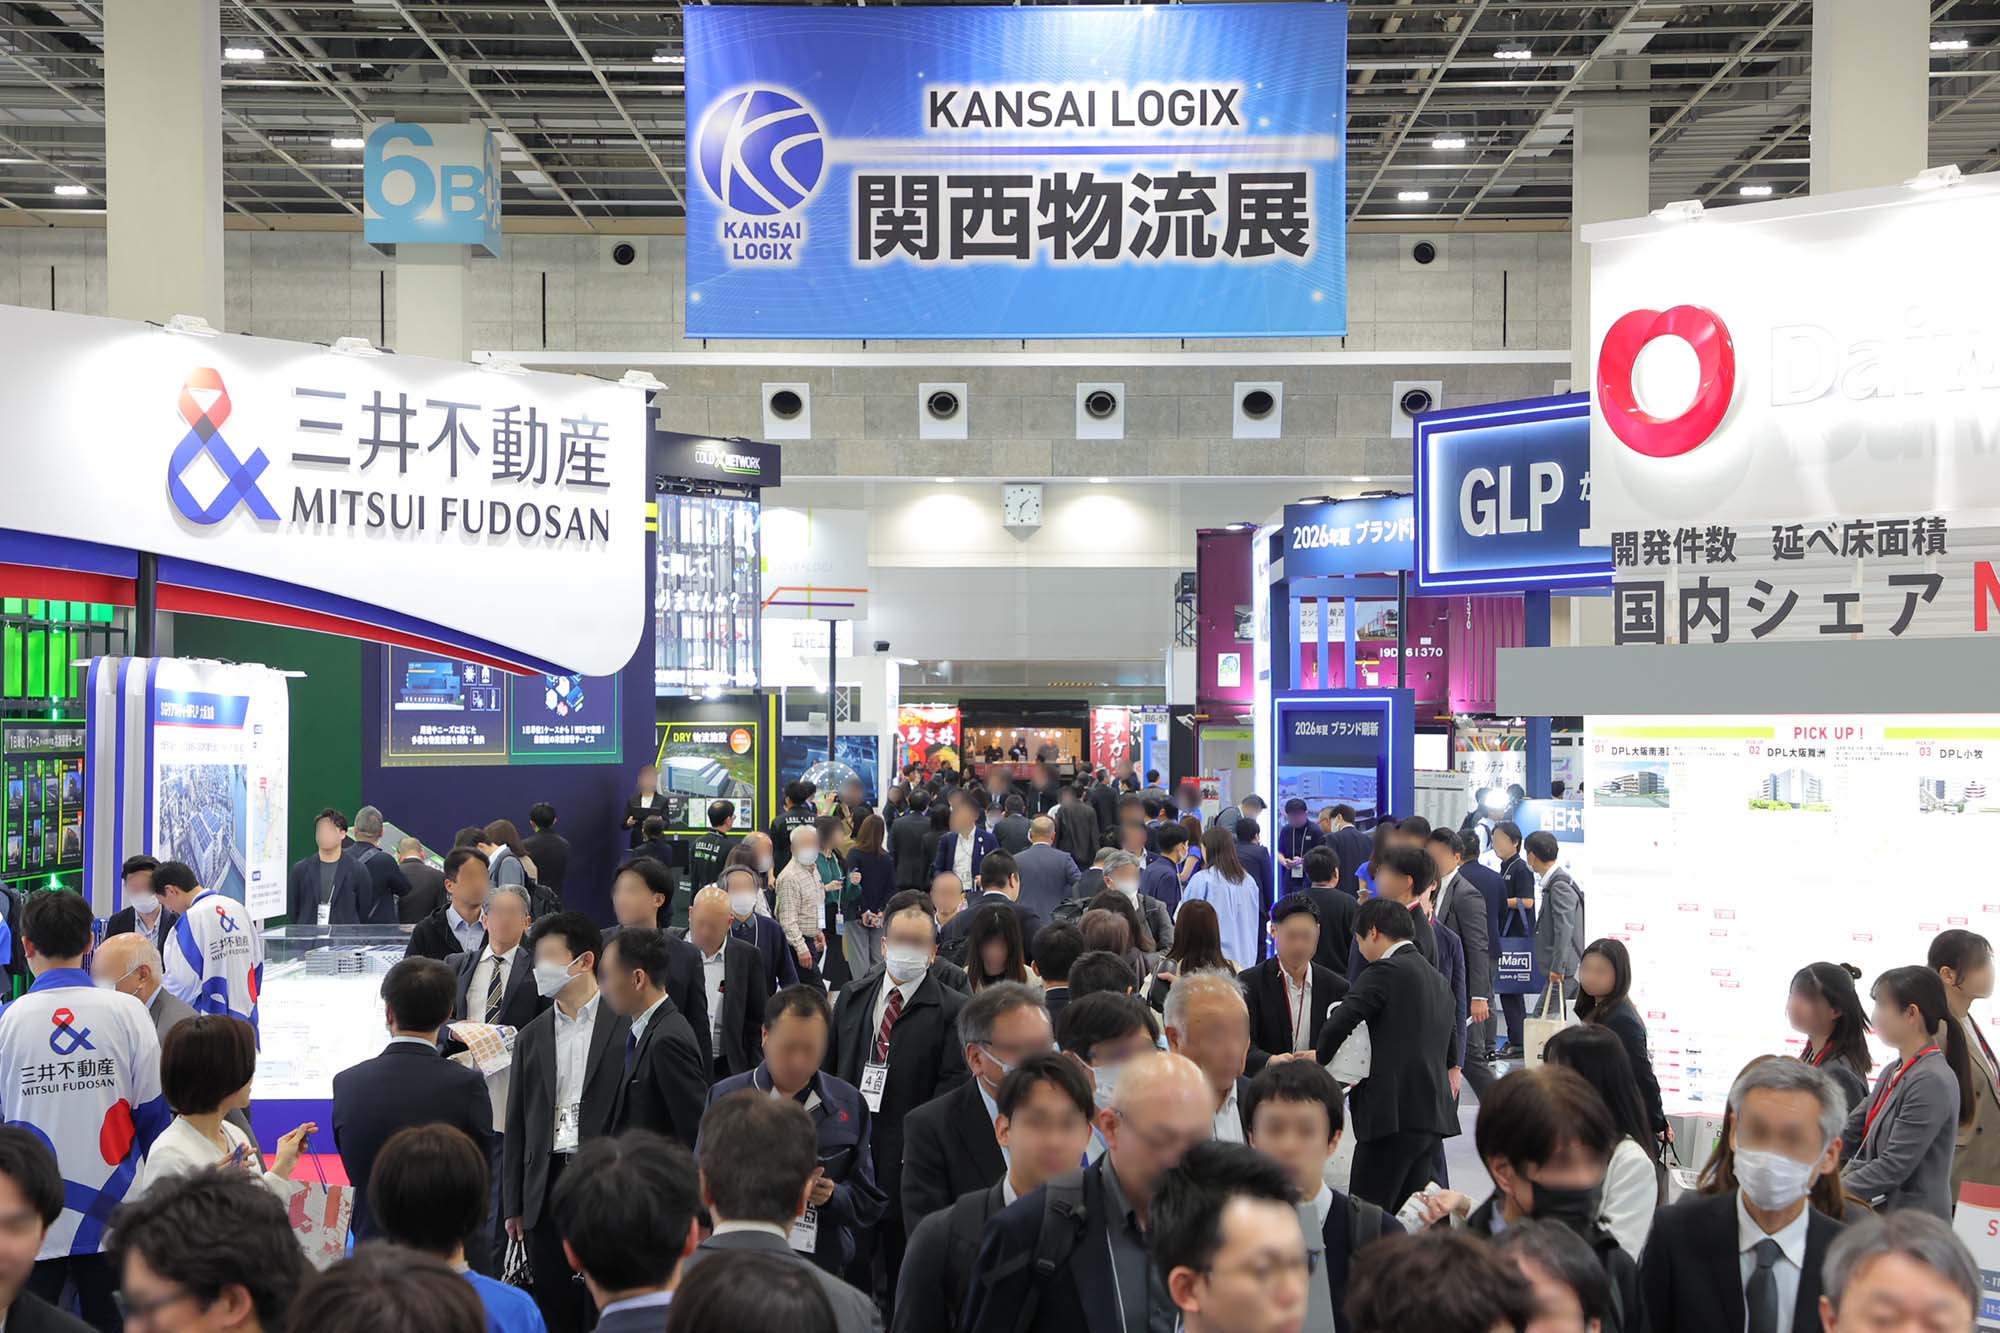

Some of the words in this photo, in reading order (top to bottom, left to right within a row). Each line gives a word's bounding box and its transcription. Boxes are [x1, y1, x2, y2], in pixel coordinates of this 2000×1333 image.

[930, 89, 1095, 128] KANSAI
[1112, 88, 1239, 127] LOGIX
[363, 121, 485, 221] 6B
[857, 171, 1310, 261] 関西物流展
[724, 221, 800, 239] KANSAI
[733, 243, 792, 260] LOGIX
[291, 387, 610, 487] 三井不動産
[1459, 461, 1564, 537] GLP
[292, 486, 424, 531] MITSUI
[441, 496, 609, 542] FUDOSAN
[1611, 525, 1737, 567] 開発件数
[1772, 516, 1948, 562] 延べ床面積
[1614, 573, 1944, 646] 国内シェア
[673, 732, 691, 743] DRY
[1794, 726, 1828, 740] PICK
[1749, 745, 1760, 756] 02
[1919, 747, 1931, 757] 03
[1540, 807, 1584, 833] 西日本
[21, 1058, 115, 1085] 三井不動産
[22, 1083, 59, 1096] MITSUI
[63, 1078, 115, 1092] FUDOSAN
